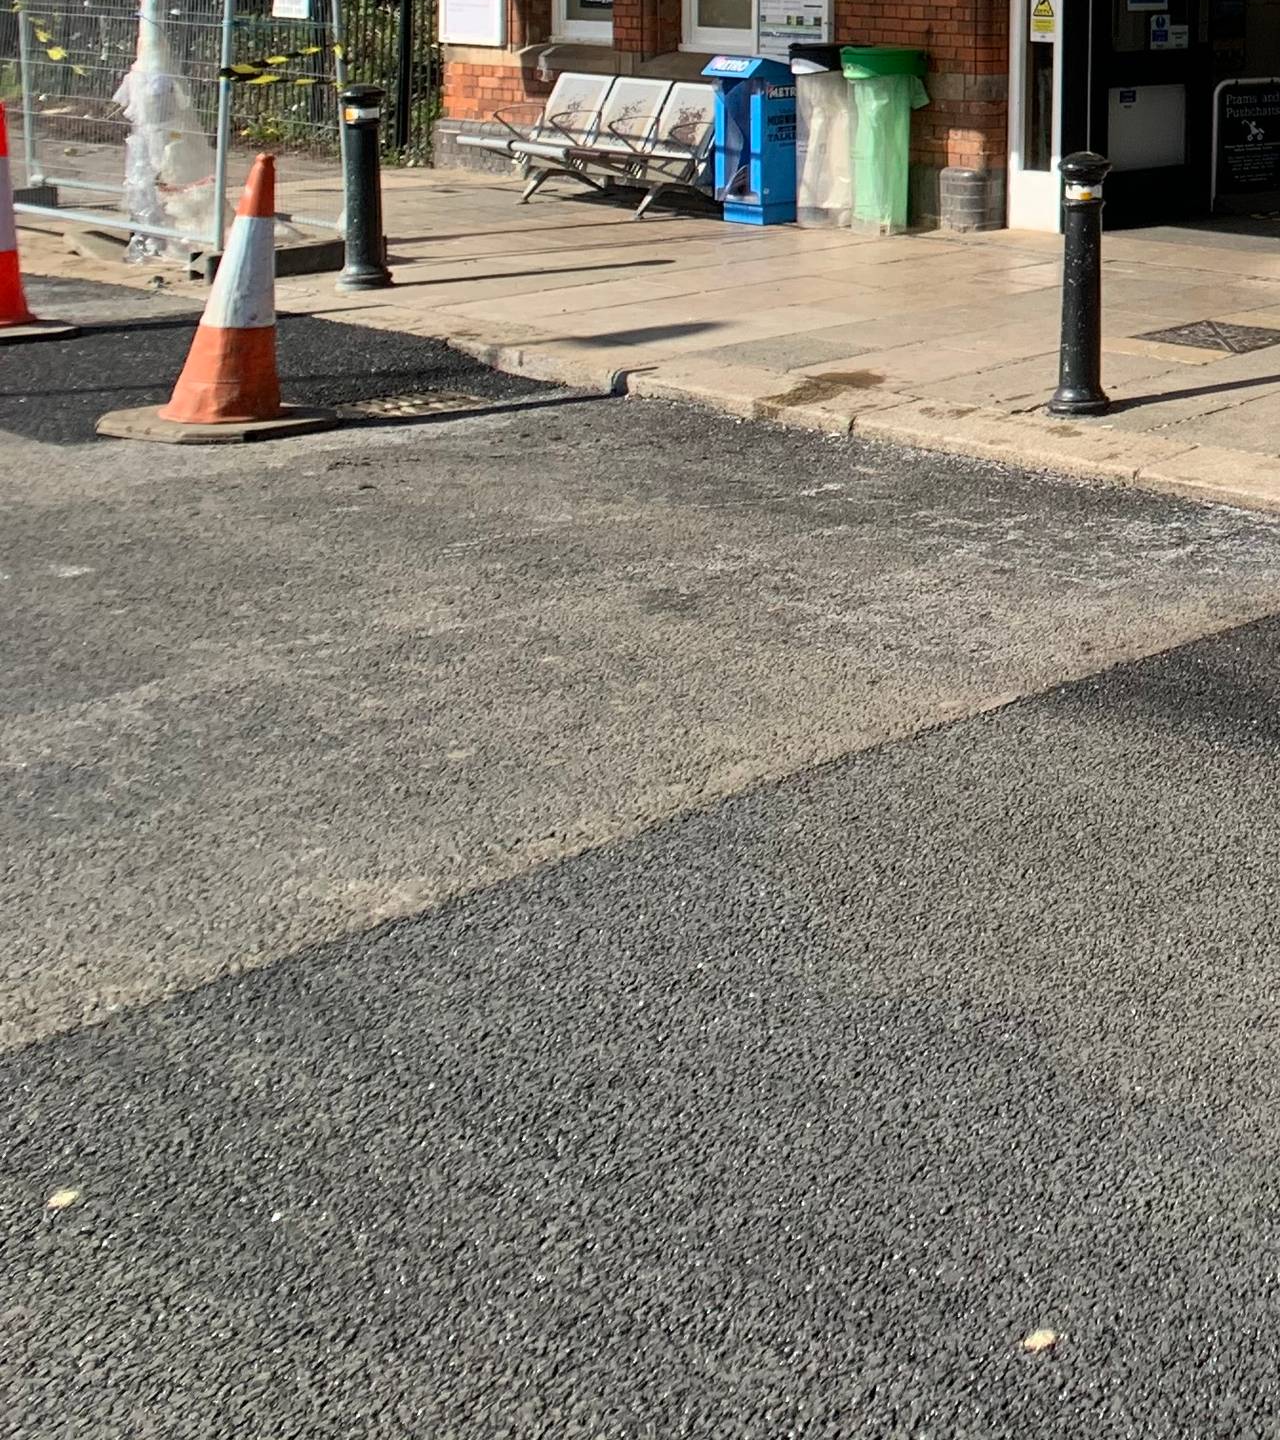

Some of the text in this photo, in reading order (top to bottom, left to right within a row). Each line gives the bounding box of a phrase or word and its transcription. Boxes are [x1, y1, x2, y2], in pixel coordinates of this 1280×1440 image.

[769, 86, 796, 99] METR
[1226, 92, 1280, 105] Prams and
